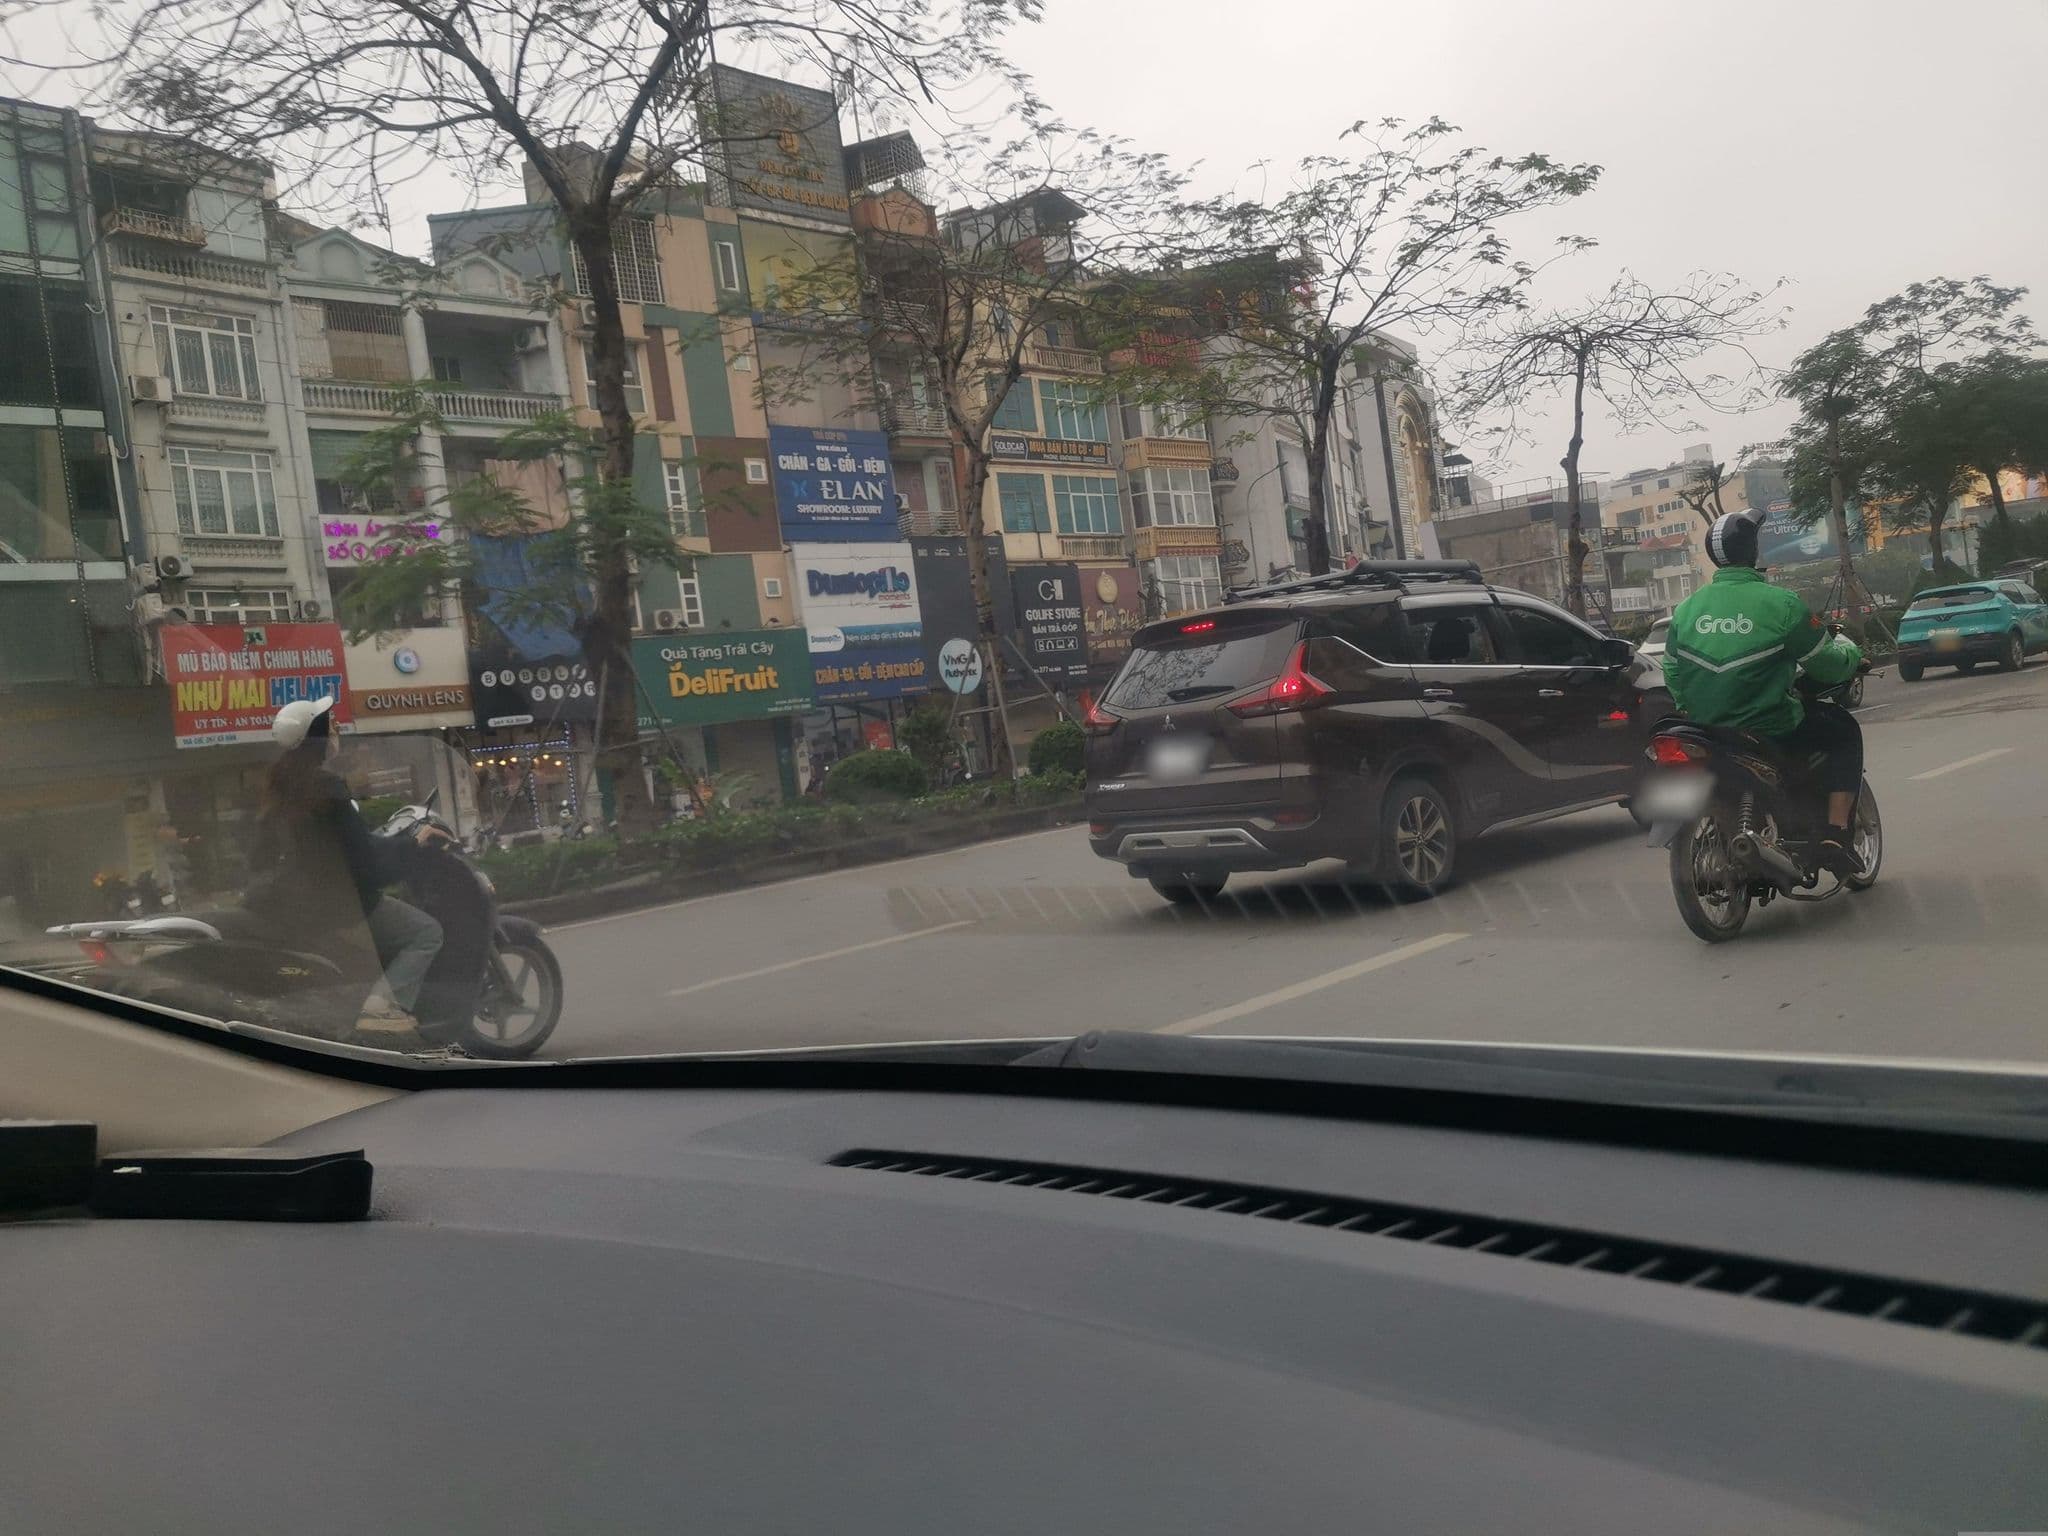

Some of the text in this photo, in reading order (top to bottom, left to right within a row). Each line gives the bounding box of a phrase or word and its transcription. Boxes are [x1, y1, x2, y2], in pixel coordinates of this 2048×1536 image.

[1029, 441, 1046, 453] MUA
[778, 452, 809, 471] CHĂN
[816, 456, 832, 472] GA
[820, 479, 884, 500] ELAN
[1025, 607, 1081, 622] GOLIFE STORE
[1695, 613, 1753, 634] Grab
[177, 649, 199, 673] MŨ
[202, 646, 228, 672] BẢO
[229, 644, 261, 670] HIỂM
[263, 647, 301, 669] CHÍNH
[690, 646, 722, 661] Tặng
[750, 641, 774, 656] Cây
[668, 664, 780, 698] DeliFruit
[176, 674, 343, 712] NHƯ MAI HELMET
[428, 690, 465, 706] LENS
[194, 717, 210, 729] UY
[235, 717, 249, 727] AN
